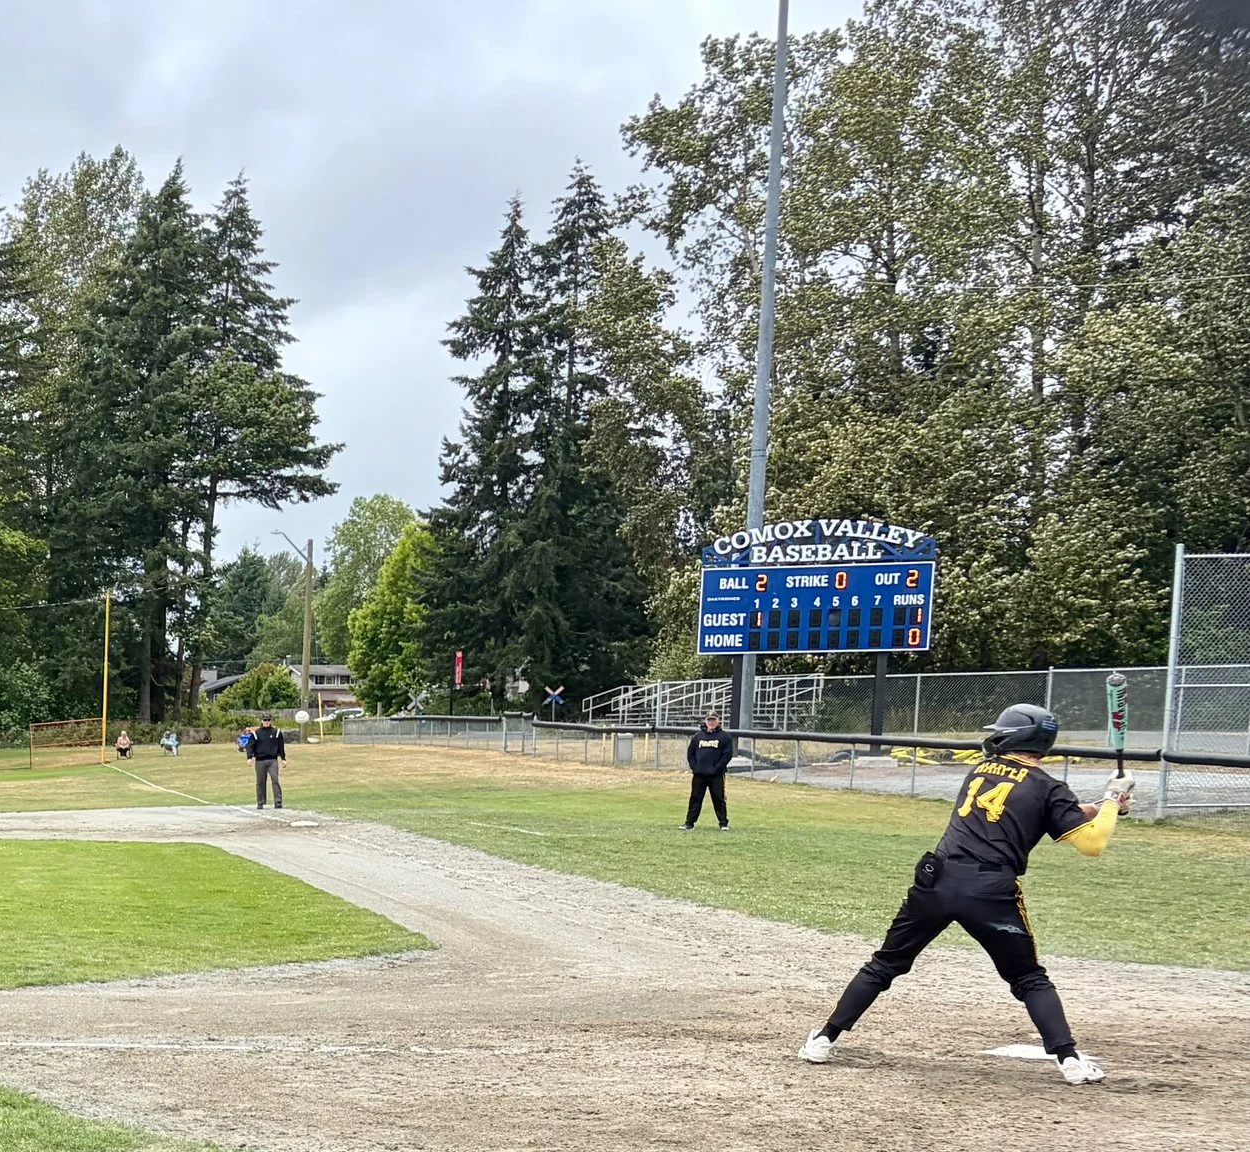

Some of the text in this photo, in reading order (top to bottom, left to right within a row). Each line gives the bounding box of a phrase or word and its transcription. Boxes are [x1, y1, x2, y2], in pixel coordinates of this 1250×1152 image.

[713, 519, 924, 555] COMOX VALLEY
[751, 542, 882, 563] BASEBALL
[719, 569, 919, 592] BALL 2 STRIKE 0 OUT 2
[754, 594, 925, 608] 1 2 3 4 5 6 7 RUNS
[703, 612, 747, 627] GUEST
[704, 628, 921, 647] HOME 0
[957, 777, 1015, 822] 14
